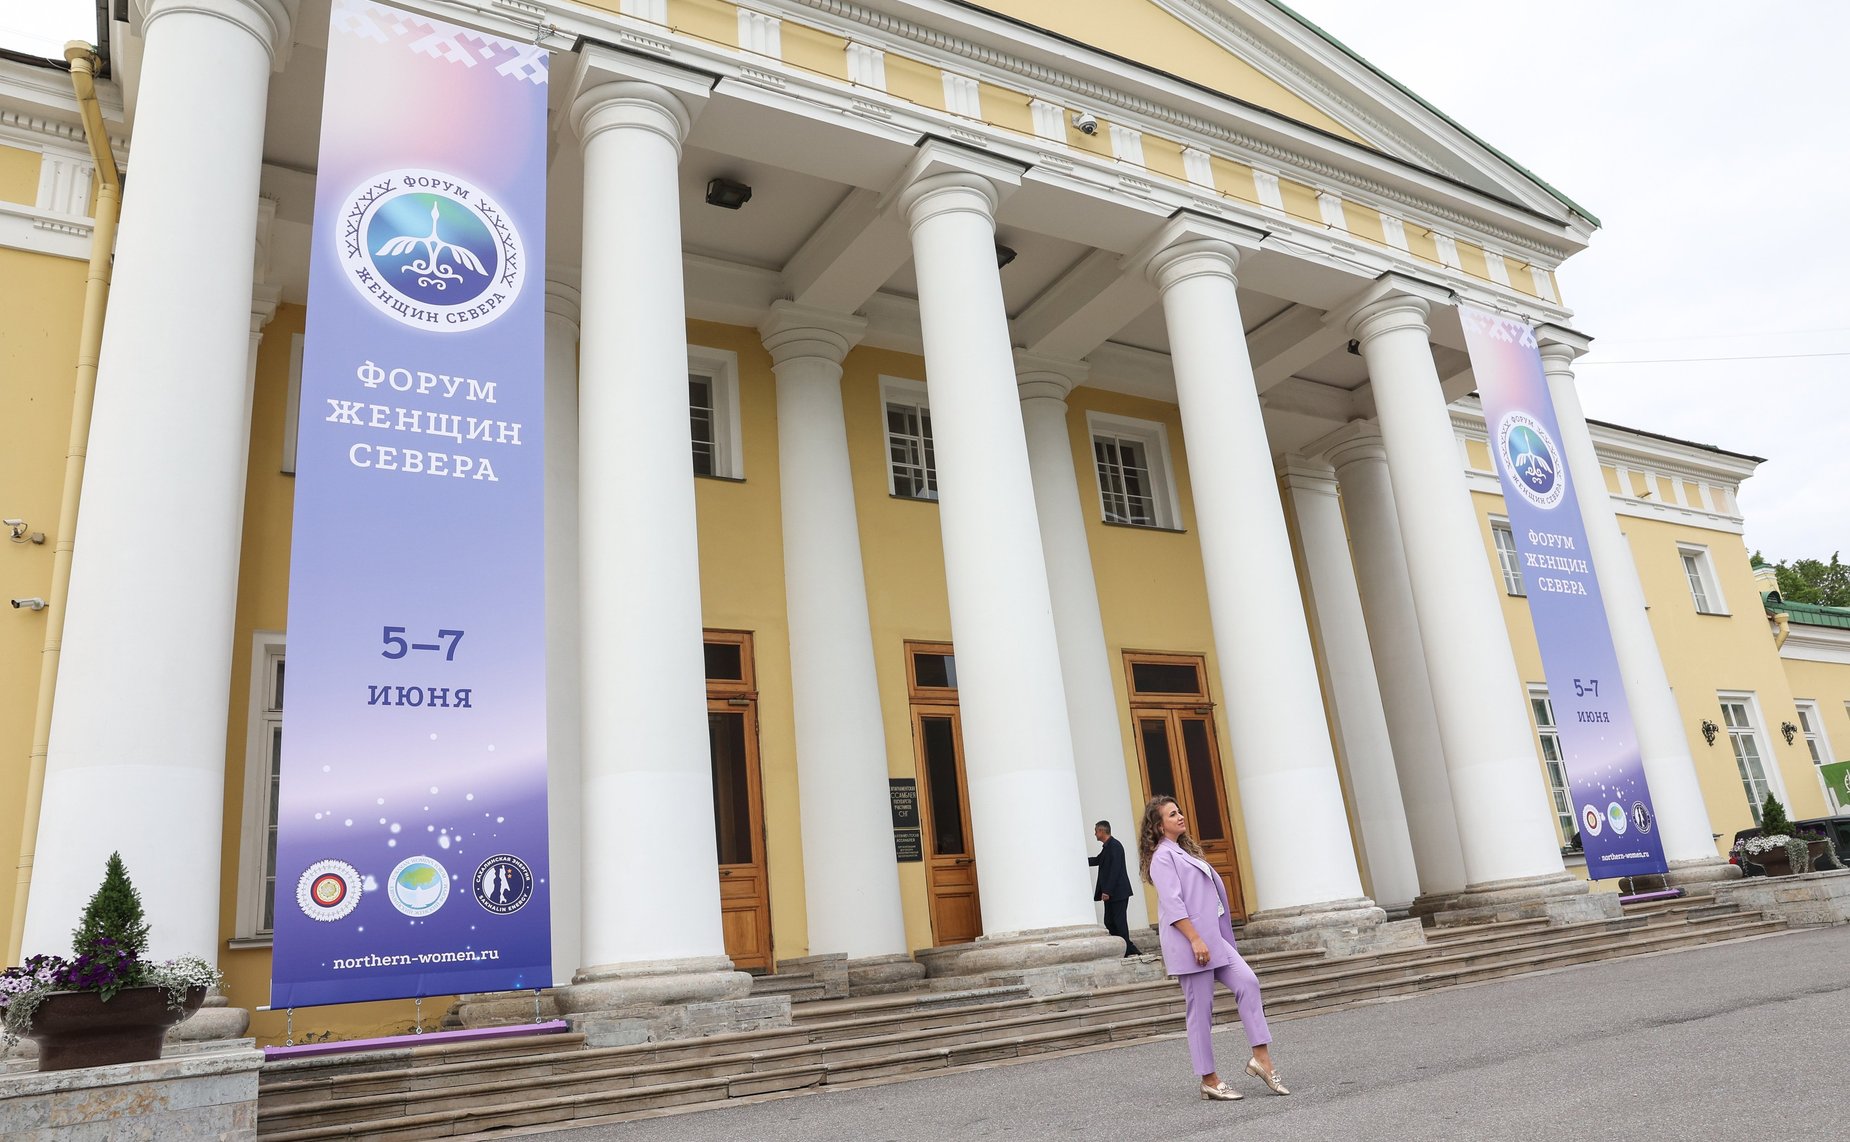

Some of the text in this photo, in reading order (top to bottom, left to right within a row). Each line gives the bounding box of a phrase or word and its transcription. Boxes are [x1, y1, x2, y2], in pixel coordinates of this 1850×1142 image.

[403, 175, 470, 200] ФОРУМ
[355, 266, 506, 325] ЖЕНЩИН СЕВЕРА
[356, 360, 497, 404] ФОРУМ
[325, 398, 522, 446] ЖЕНЩИН
[1511, 415, 1534, 427] ФОРУМ
[348, 442, 499, 482] СЕВЕРА
[1512, 474, 1546, 504] ЖЕНЩИН
[1528, 528, 1575, 550] ФОРУМ
[1524, 552, 1589, 575] ЖЕНЩИН
[1538, 577, 1587, 595] СЕВЕРА
[1601, 851, 1650, 861] northern-women.ru
[476, 856, 531, 883] САХАЛИНСКАЯ ЭНЕРГИЯ
[478, 893, 528, 912] SAKHALIN ENERGY
[332, 948, 500, 970] northern-women.ru
